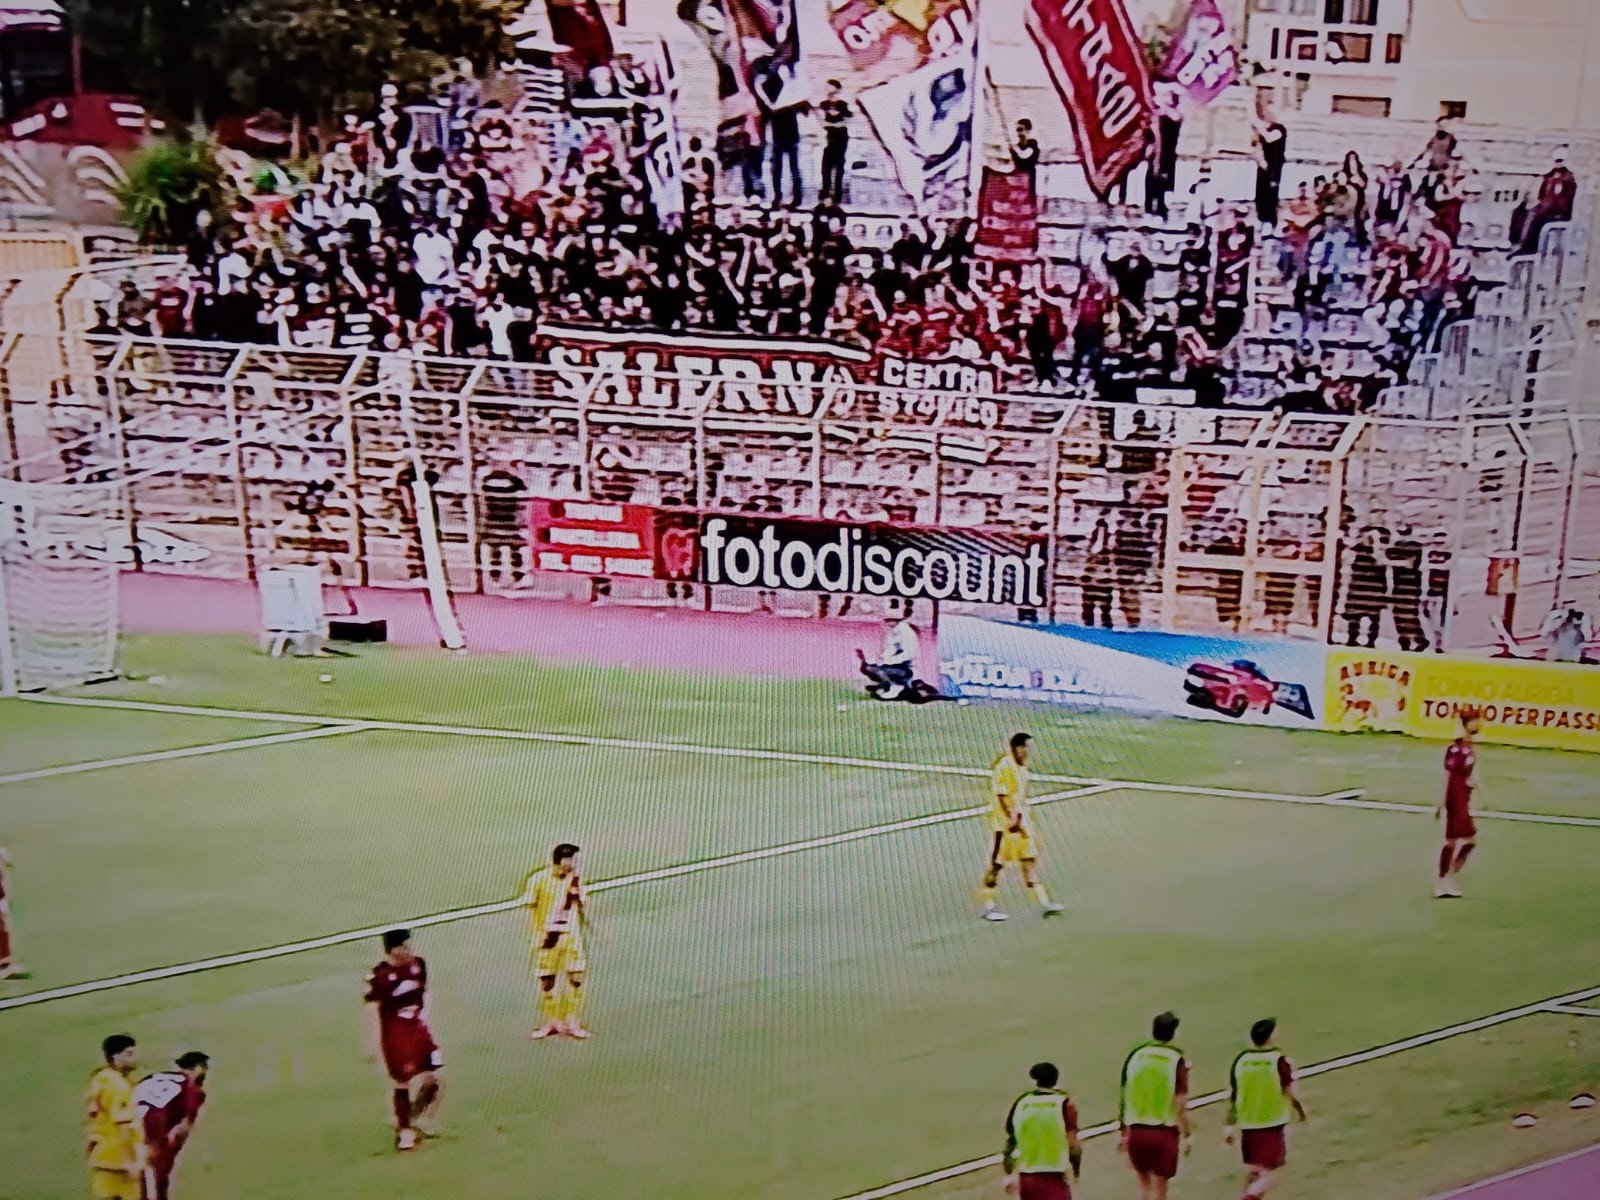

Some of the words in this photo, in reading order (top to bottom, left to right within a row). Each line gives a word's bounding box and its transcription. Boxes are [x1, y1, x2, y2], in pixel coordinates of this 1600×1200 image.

[883, 357, 994, 395] CENTRO
[700, 518, 1045, 607] fotodiscount
[1501, 705, 1540, 727] PER
